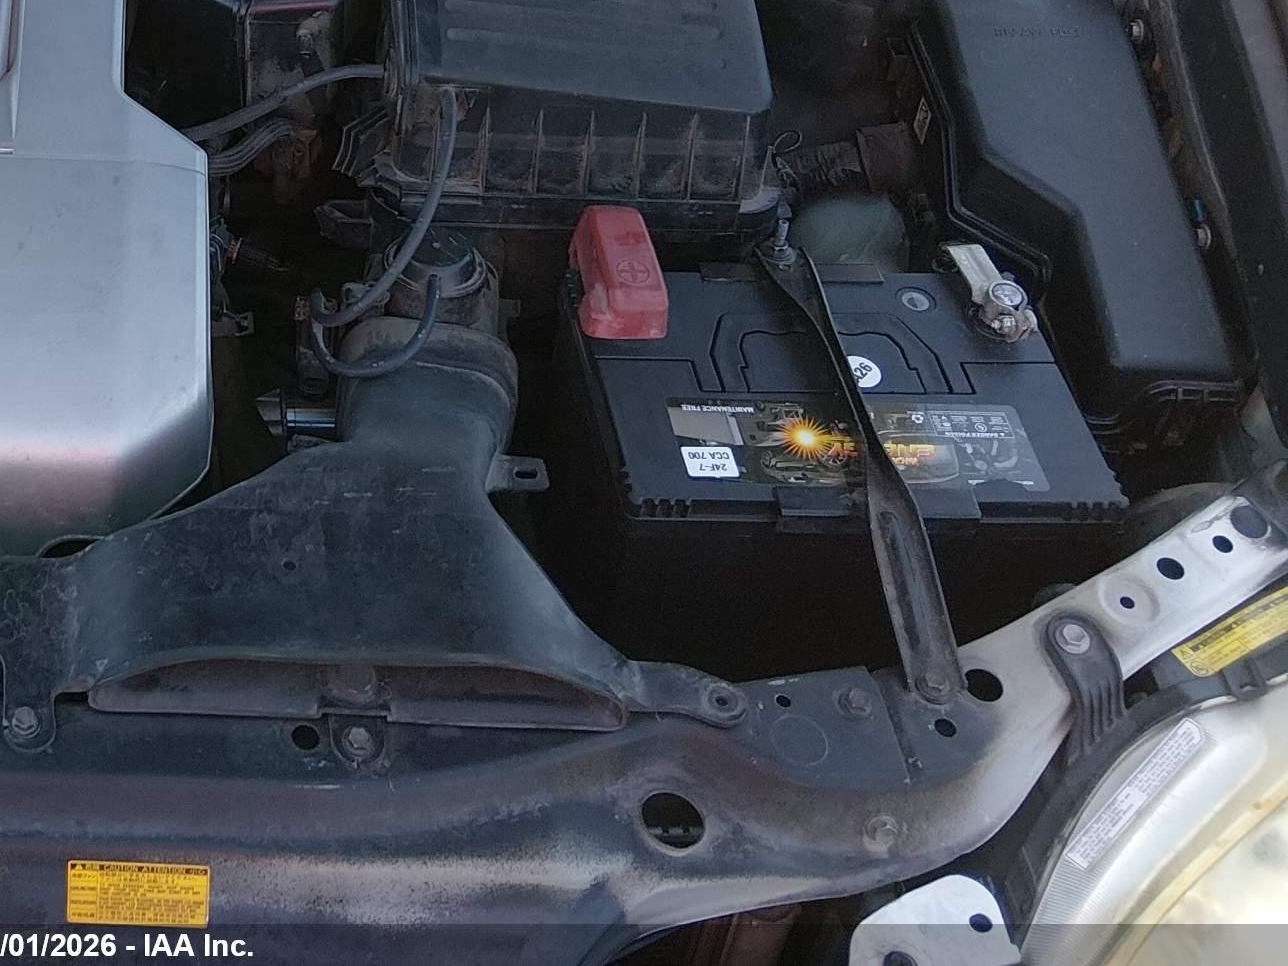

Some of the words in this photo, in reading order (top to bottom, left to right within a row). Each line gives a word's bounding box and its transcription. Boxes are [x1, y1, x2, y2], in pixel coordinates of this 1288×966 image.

[701, 405, 755, 413] MAINTENANCE
[687, 451, 709, 460] 700
[710, 452, 730, 460] CCA
[699, 463, 728, 471] 24F-7
[105, 864, 139, 872] CAUTION
[141, 865, 185, 874] ATTENTION
